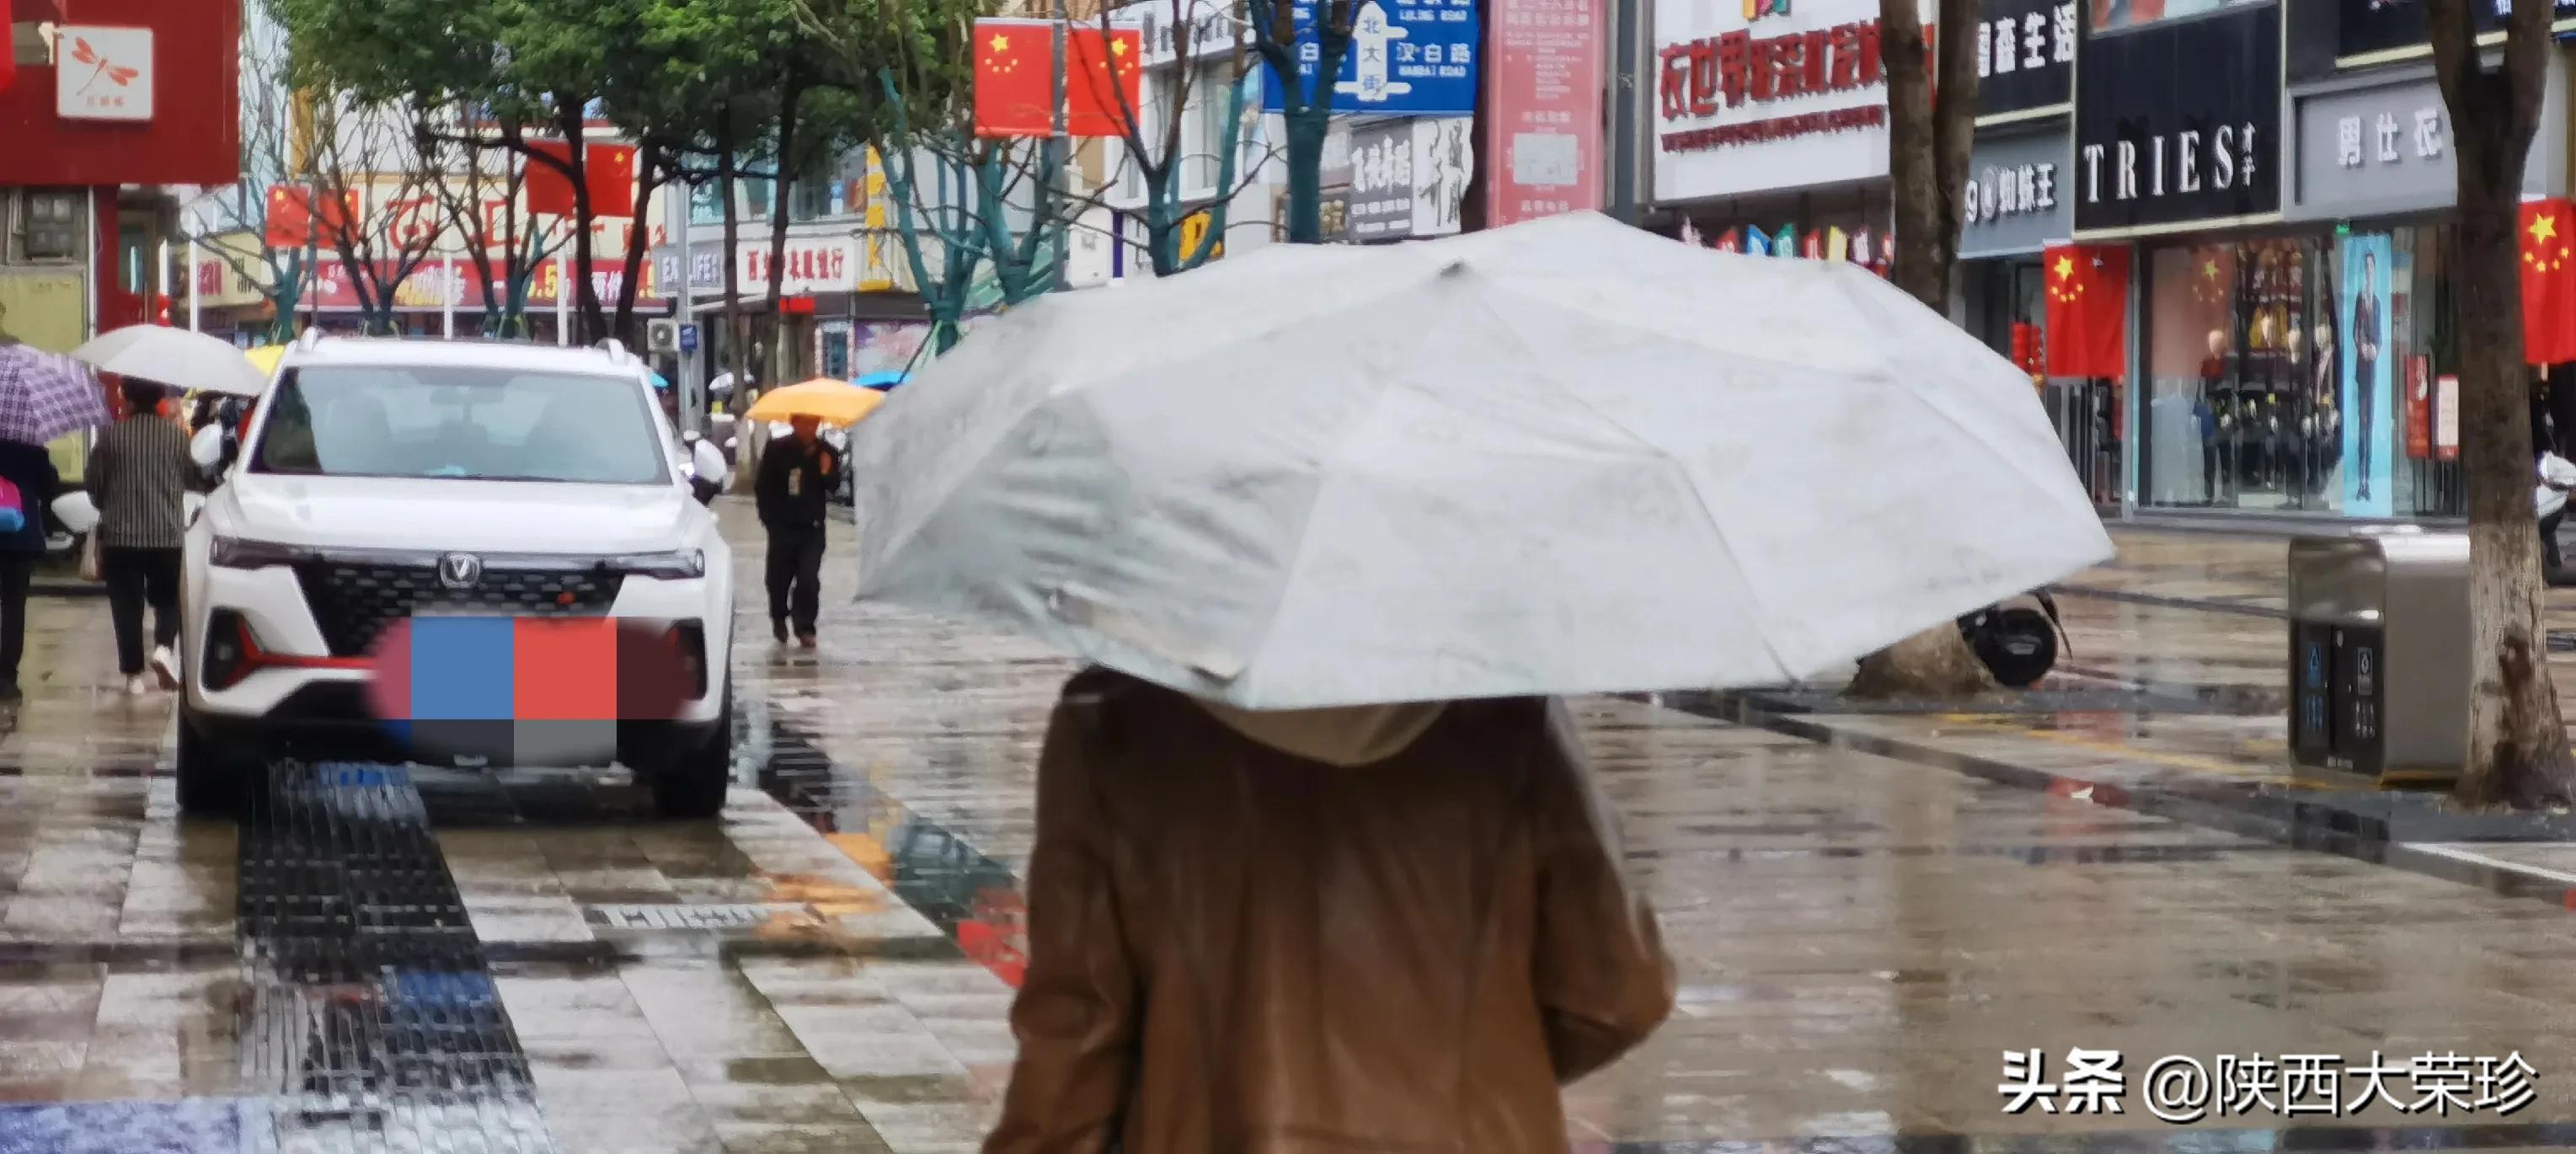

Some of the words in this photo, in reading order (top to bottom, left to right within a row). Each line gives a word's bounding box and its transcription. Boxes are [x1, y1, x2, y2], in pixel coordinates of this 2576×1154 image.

[1362, 15, 1383, 93] 北大街
[1396, 42, 1471, 63] 汉白路
[2082, 125, 2234, 203] TRIES
